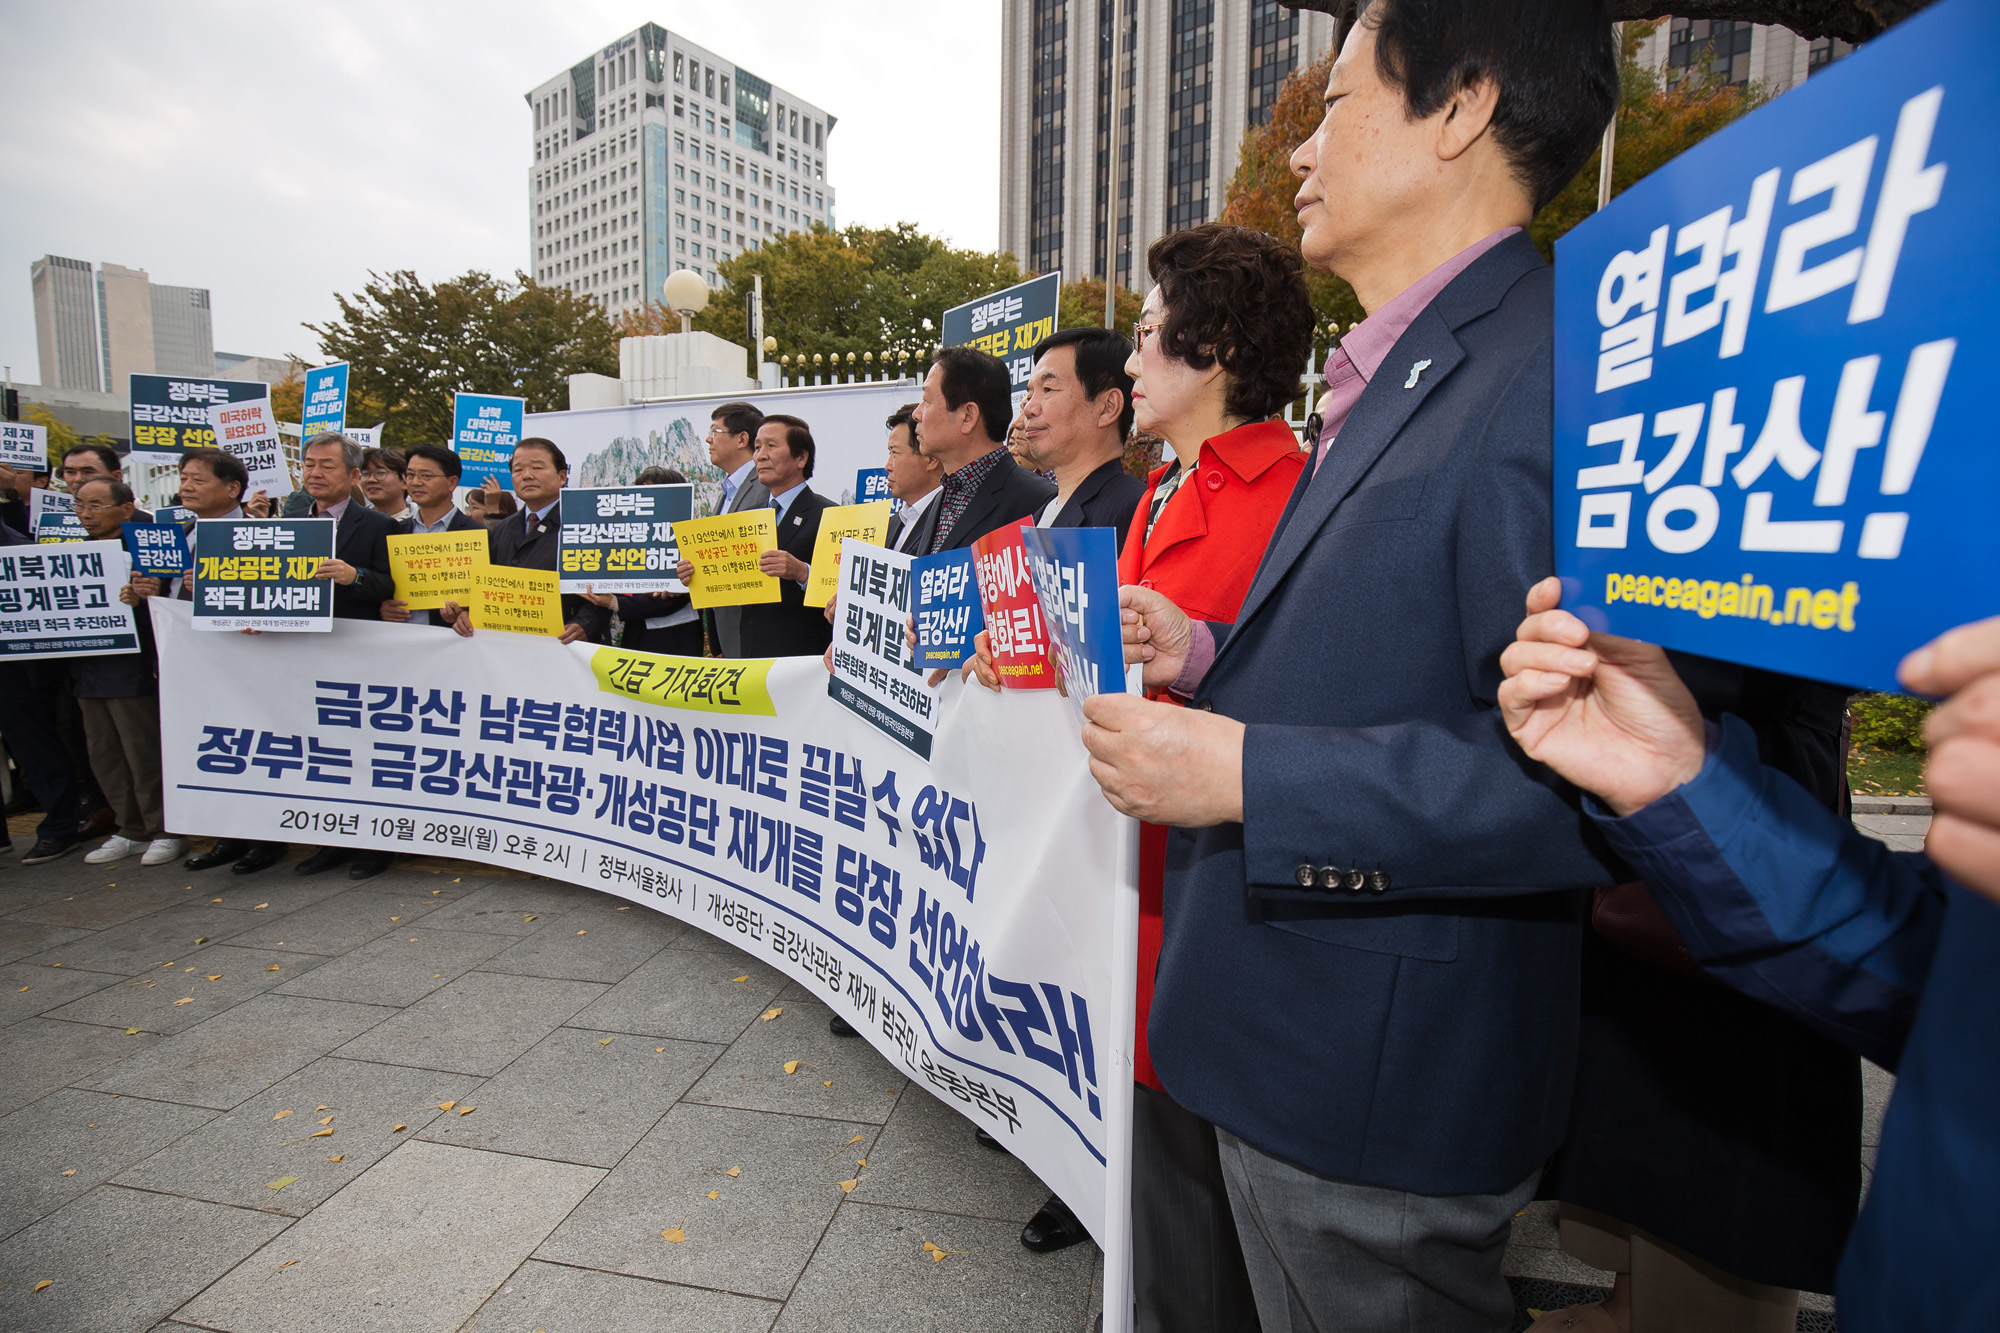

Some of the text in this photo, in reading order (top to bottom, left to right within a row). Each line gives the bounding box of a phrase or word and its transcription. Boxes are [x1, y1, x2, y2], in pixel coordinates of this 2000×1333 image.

[1595, 85, 1947, 394] 열려라
[971, 296, 1023, 333] 정부는
[1013, 316, 1053, 352] 재개
[168, 382, 229, 403] 정부는
[220, 407, 262, 424] 미국허락
[479, 406, 502, 419] 남북
[0, 427, 34, 440] 제재
[134, 425, 178, 446] 당장
[224, 422, 267, 440] 필요없다
[467, 418, 511, 433] 대학생은
[0, 440, 34, 453] 말고
[256, 438, 276, 452] 열자
[459, 430, 518, 446] 만나고 싶다
[1575, 337, 1957, 559] 금강산!
[239, 453, 276, 471] 강산!
[865, 475, 891, 496] 열려
[596, 493, 655, 517] 정부는
[134, 528, 177, 548] 열려라
[232, 526, 295, 550] 정부는
[562, 521, 676, 545] 금강산관광 재
[682, 523, 768, 546] 9.19선언에서 합의한
[138, 550, 183, 567] 금강산!
[394, 543, 451, 556] 9.19선언에서
[695, 542, 758, 560] 개성공단 정상화
[198, 556, 282, 581] 개성공단
[405, 556, 473, 569] 개성공단 정상화
[562, 549, 603, 572] 당장
[701, 559, 759, 576] 즉각 이행하라!
[408, 570, 471, 583] 즉각 이행하라!
[475, 575, 524, 590] 9.19선언에서
[920, 561, 970, 606] 열려라
[0, 584, 110, 613] 핑계말고
[204, 586, 321, 611] 적극 나서라!
[440, 588, 471, 596] 비상대책위원
[482, 590, 545, 606] 개성공단 정상화
[1035, 555, 1089, 644] 열려라
[1606, 572, 1860, 632] peaceagain.net
[484, 604, 544, 620] 즉각 이행하라!
[0, 615, 128, 634] 북협력 적극 추진하라
[918, 605, 971, 647] 금강산!
[987, 603, 1045, 659] 평화로!
[925, 649, 960, 661] peaceagain.net
[998, 661, 1044, 678] peaceagain.net
[608, 657, 747, 706] 긴급 기자회견
[834, 647, 933, 721] 남북협력 적극 추진하라
[314, 680, 466, 737] 금강산
[480, 694, 685, 776] 남북협력사업
[693, 726, 789, 802] 이대로
[911, 784, 987, 904] 없다
[197, 725, 354, 786] 정부는
[727, 805, 823, 904] 재개를
[835, 843, 902, 951] 당장
[909, 887, 1102, 1122] 선언하라!
[280, 810, 360, 836] 2019년
[371, 817, 416, 842] 10월
[423, 823, 498, 854] 28일(월)
[502, 834, 538, 860] 오후
[545, 843, 572, 869] 2시
[598, 855, 683, 906] 정부서울청사
[846, 971, 877, 1024] 재개
